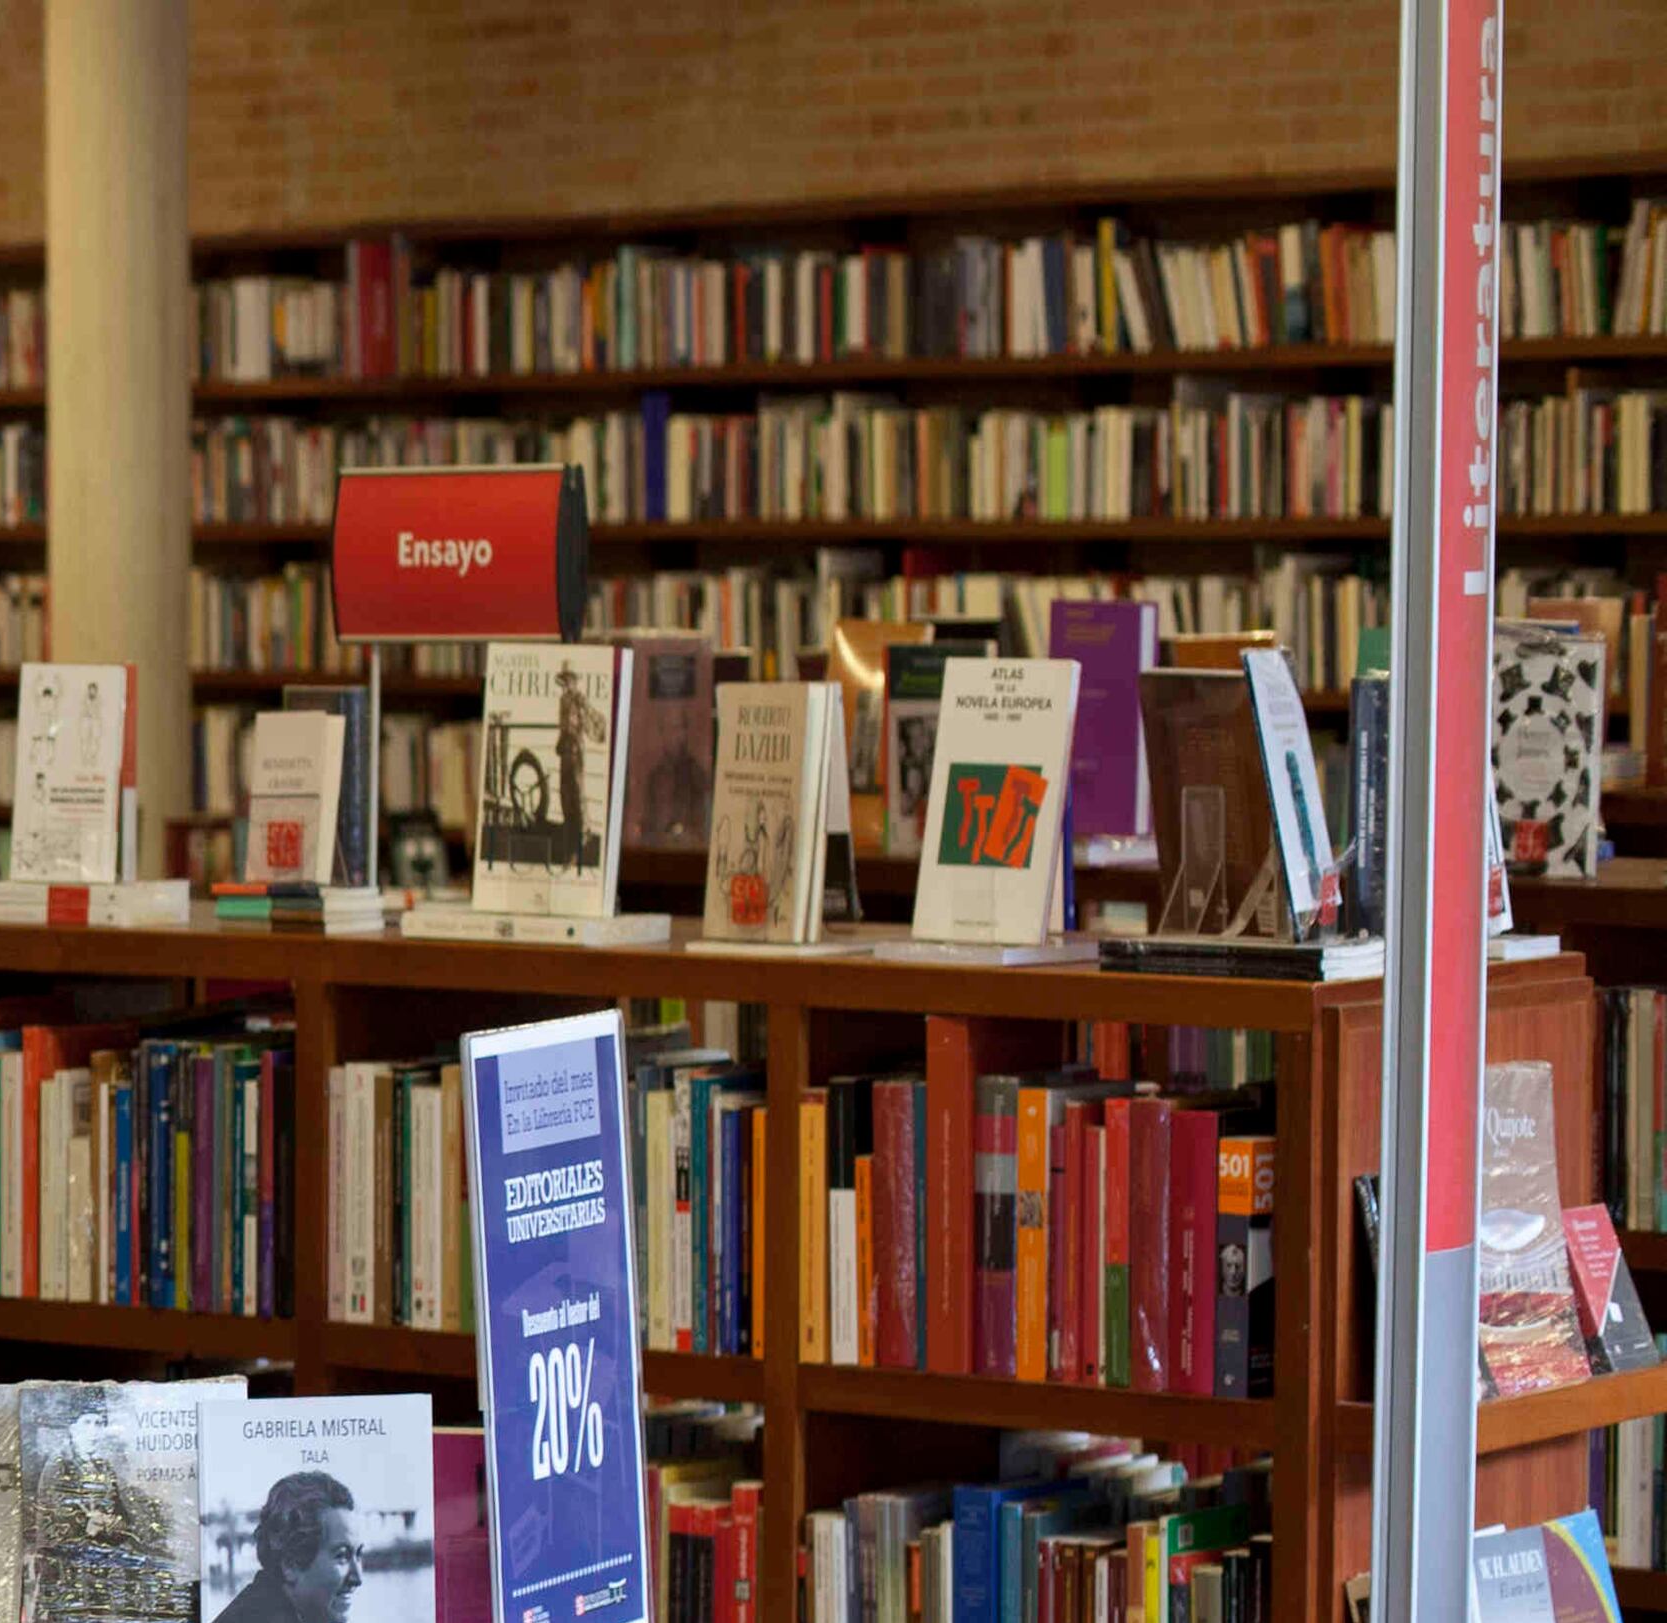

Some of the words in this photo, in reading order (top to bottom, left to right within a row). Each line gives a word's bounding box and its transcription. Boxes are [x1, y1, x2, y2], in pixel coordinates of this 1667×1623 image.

[1463, 16, 1497, 596] Literatura
[397, 532, 493, 576] Ensayo
[956, 696, 997, 709] NOVELA
[1001, 697, 1053, 710] EUROPEA
[504, 1075, 550, 1104] Invitado
[552, 1069, 569, 1093] del
[571, 1071, 594, 1092] mes
[574, 1097, 595, 1123] FCE
[1218, 1152, 1250, 1178] 501
[504, 1159, 604, 1212] EDITORIALES
[506, 1197, 606, 1244] UNIVERSITARIAS
[529, 1338, 604, 1480] 20%
[242, 1417, 317, 1439] GABRIELA
[321, 1416, 388, 1437] MISTRAL
[300, 1448, 330, 1464] TALA
[137, 1465, 183, 1482] POEMAS
